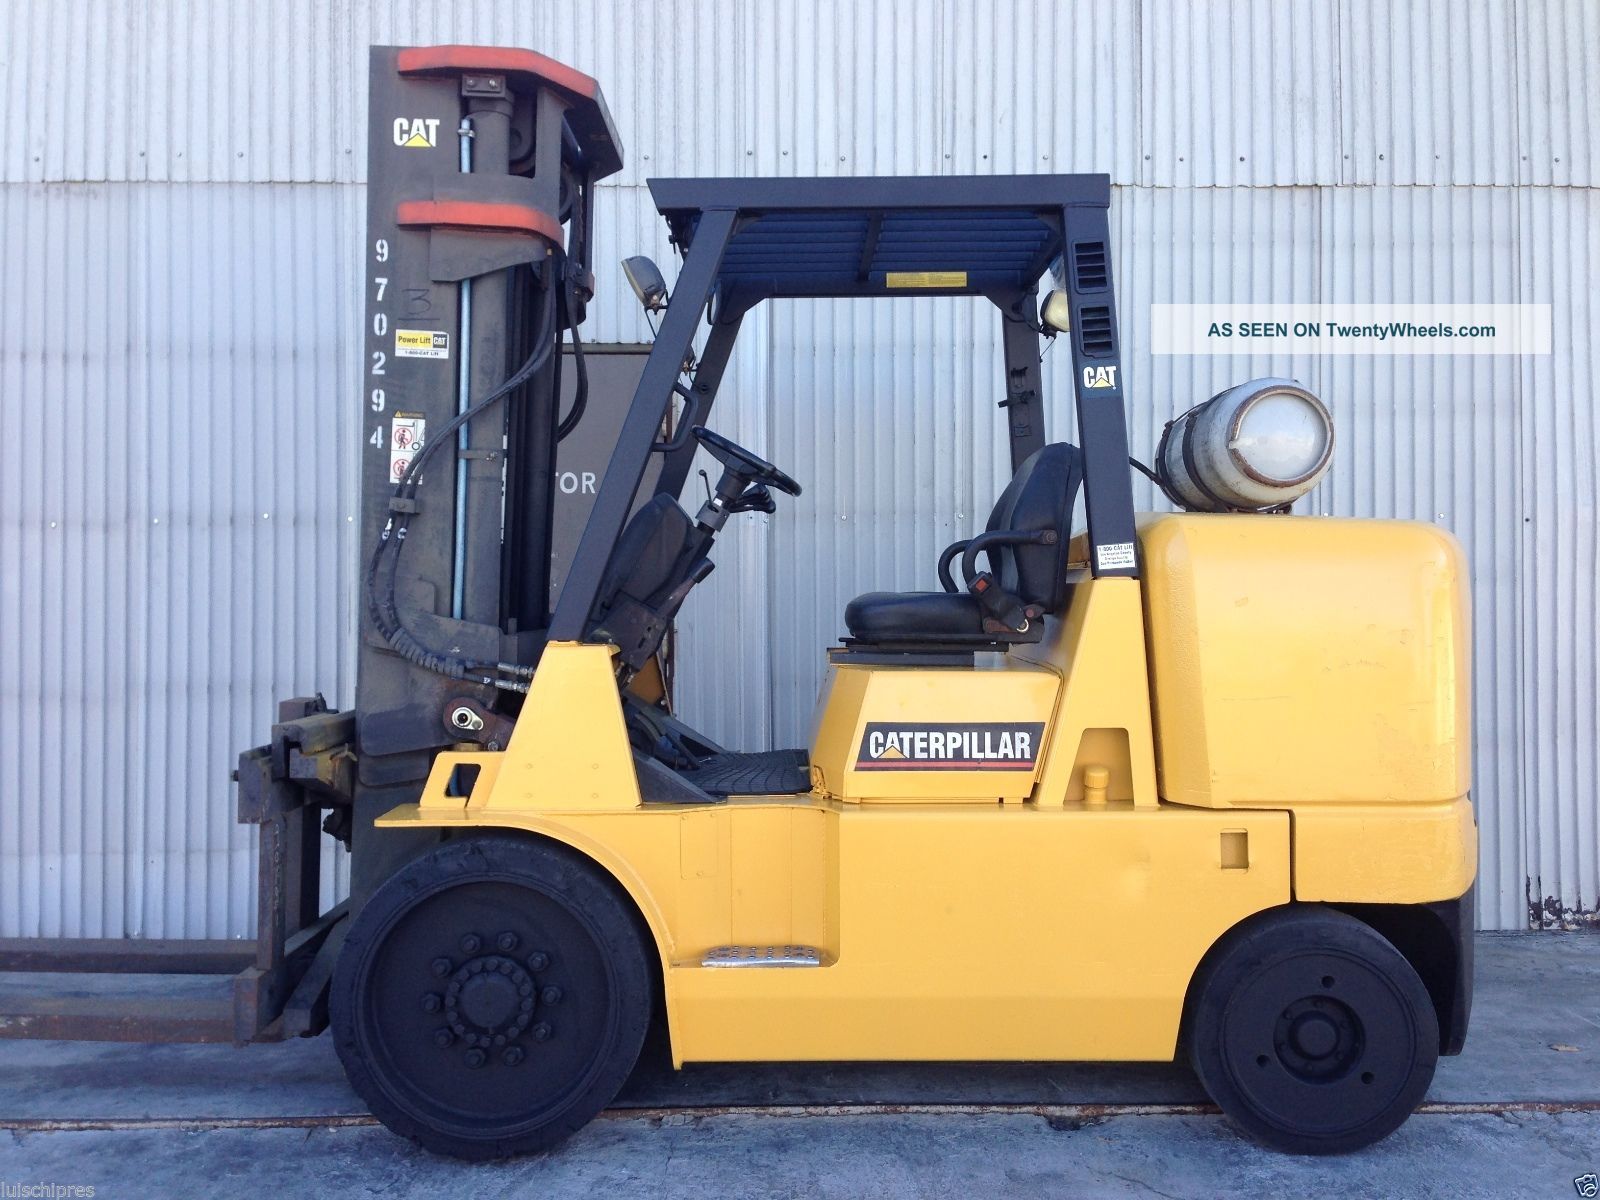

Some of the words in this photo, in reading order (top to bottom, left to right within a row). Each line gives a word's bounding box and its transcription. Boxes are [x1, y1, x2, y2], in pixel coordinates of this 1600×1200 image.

[393, 117, 440, 147] CAT
[398, 335, 418, 343] Power
[420, 336, 431, 344] Lift
[1083, 366, 1117, 388] CAT
[555, 471, 596, 494] OR
[869, 731, 1031, 759] CATERPILLAR
